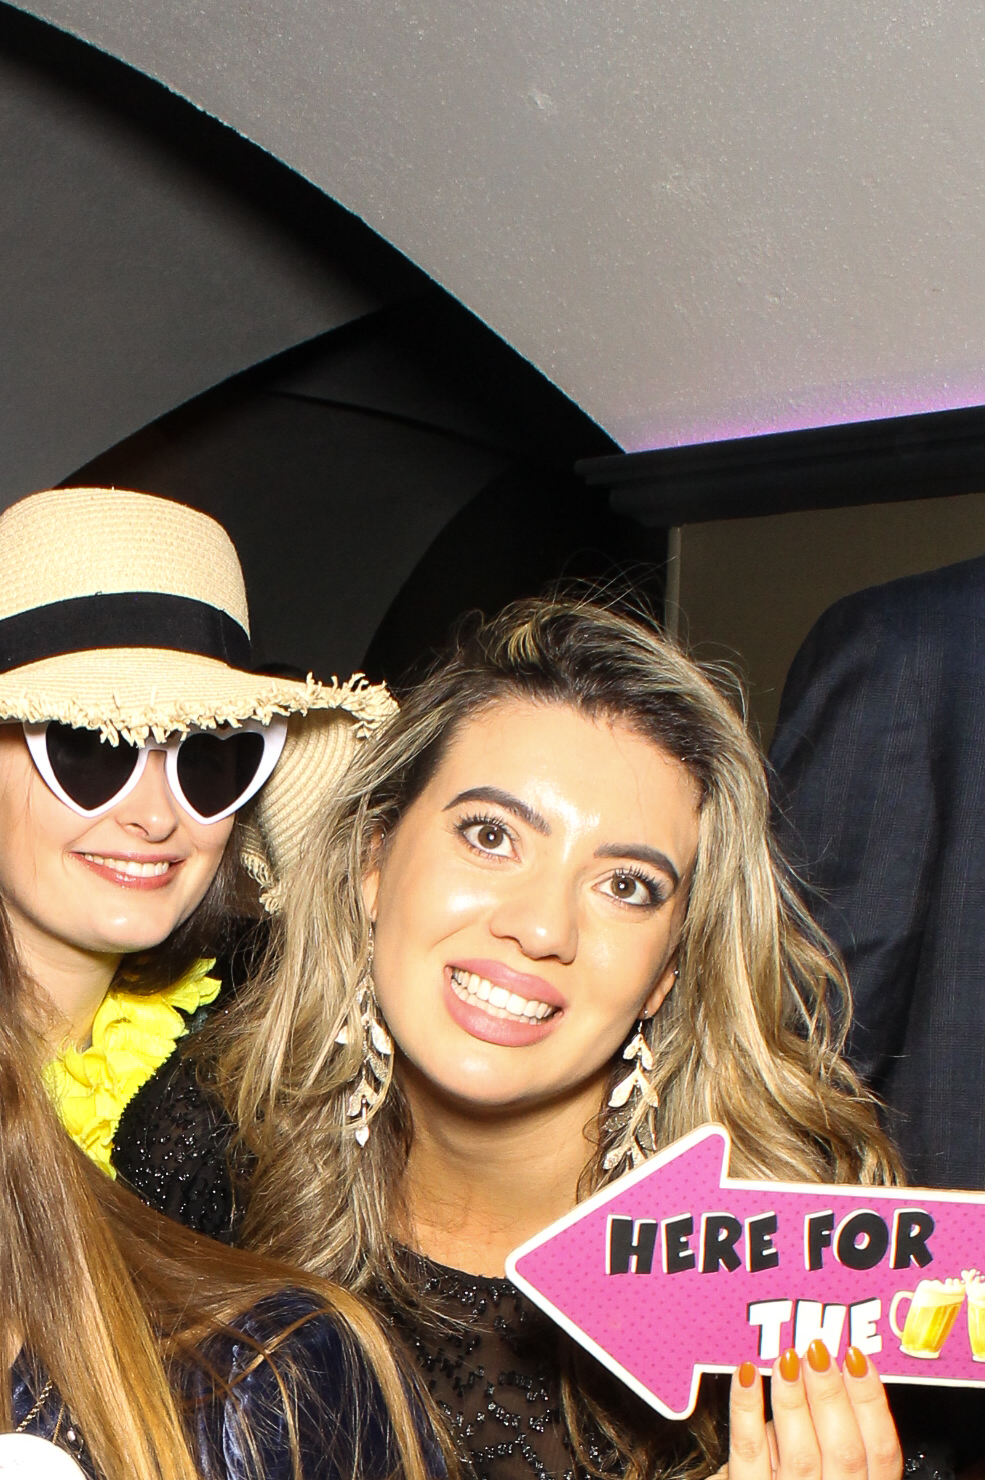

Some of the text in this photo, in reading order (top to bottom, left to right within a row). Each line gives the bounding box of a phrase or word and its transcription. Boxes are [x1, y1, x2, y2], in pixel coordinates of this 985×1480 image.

[605, 1207, 936, 1275] HERE FOR
[746, 1298, 883, 1360] THE
